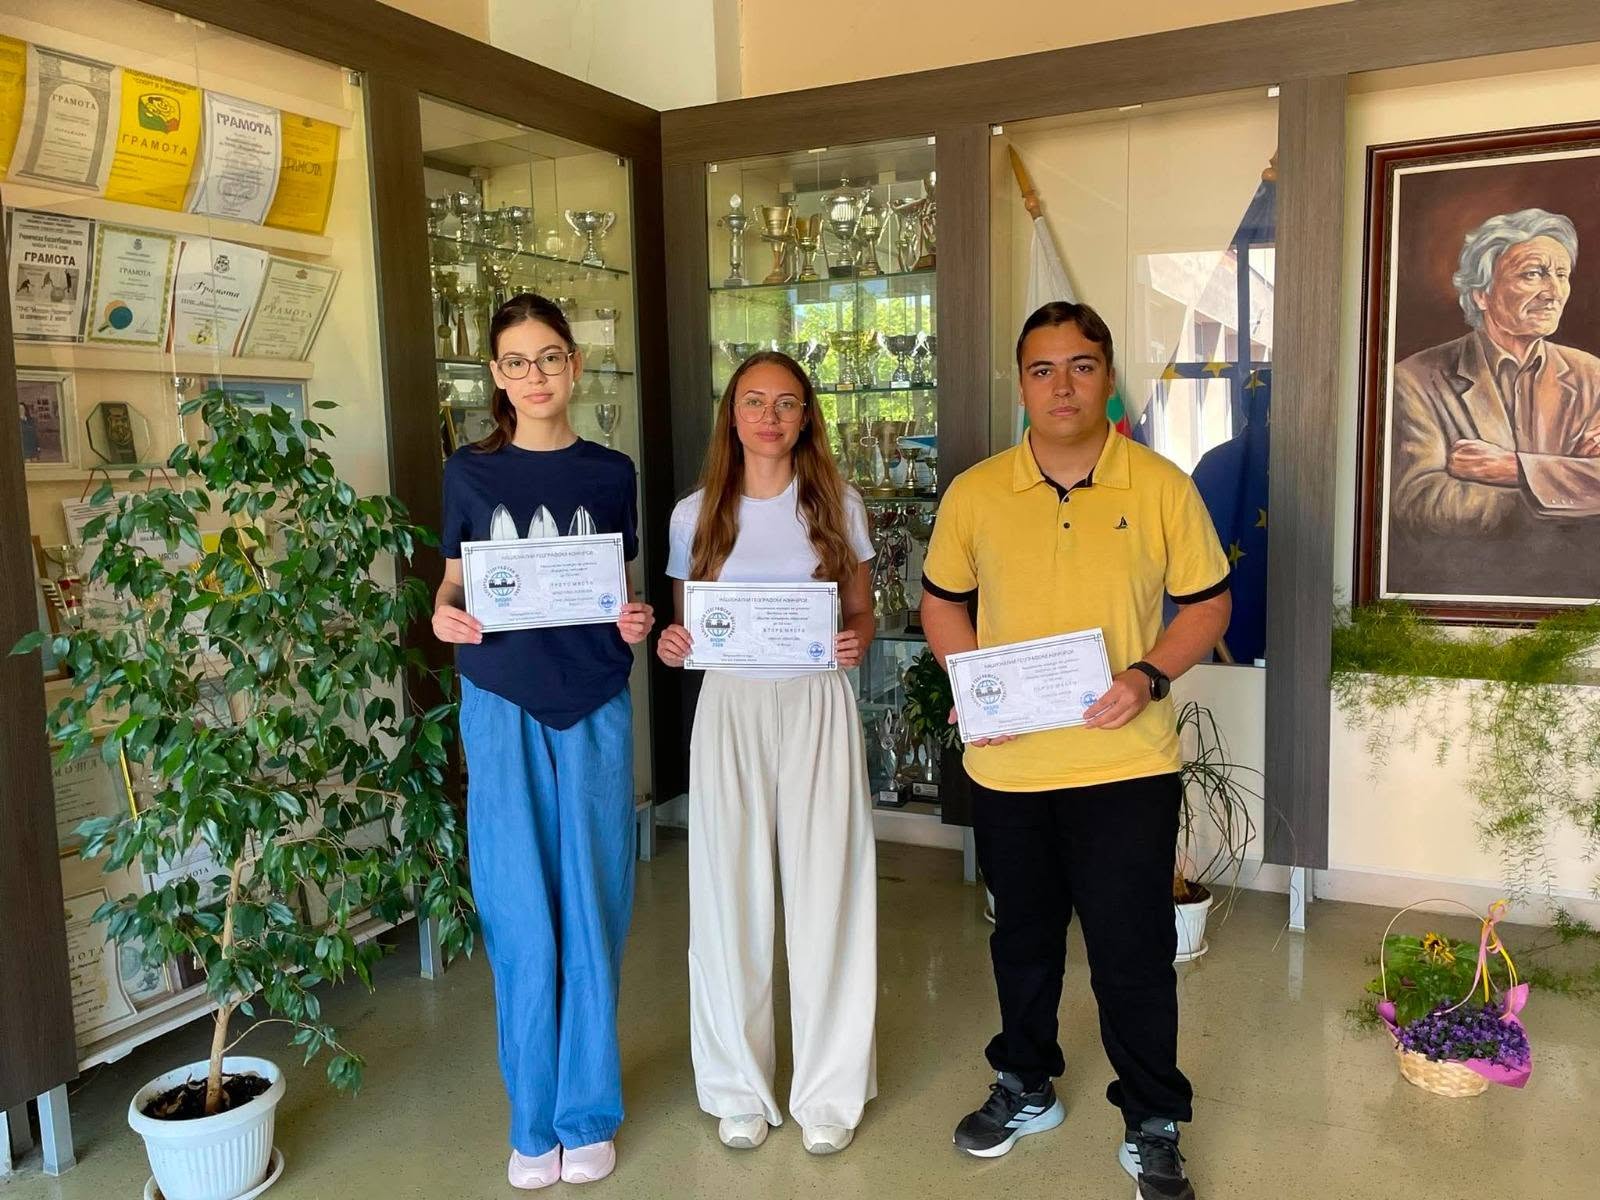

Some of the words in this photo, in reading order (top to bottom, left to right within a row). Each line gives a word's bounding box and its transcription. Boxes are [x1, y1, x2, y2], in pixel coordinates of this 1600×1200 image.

[52, 94, 96, 110] ГРАМОТА
[216, 112, 273, 136] ГРАМОТА
[122, 134, 188, 157] ГРАМОТА
[24, 251, 76, 266] ГРАМОТА
[119, 267, 152, 278] ГРАМОТА
[190, 281, 240, 298] Грамота
